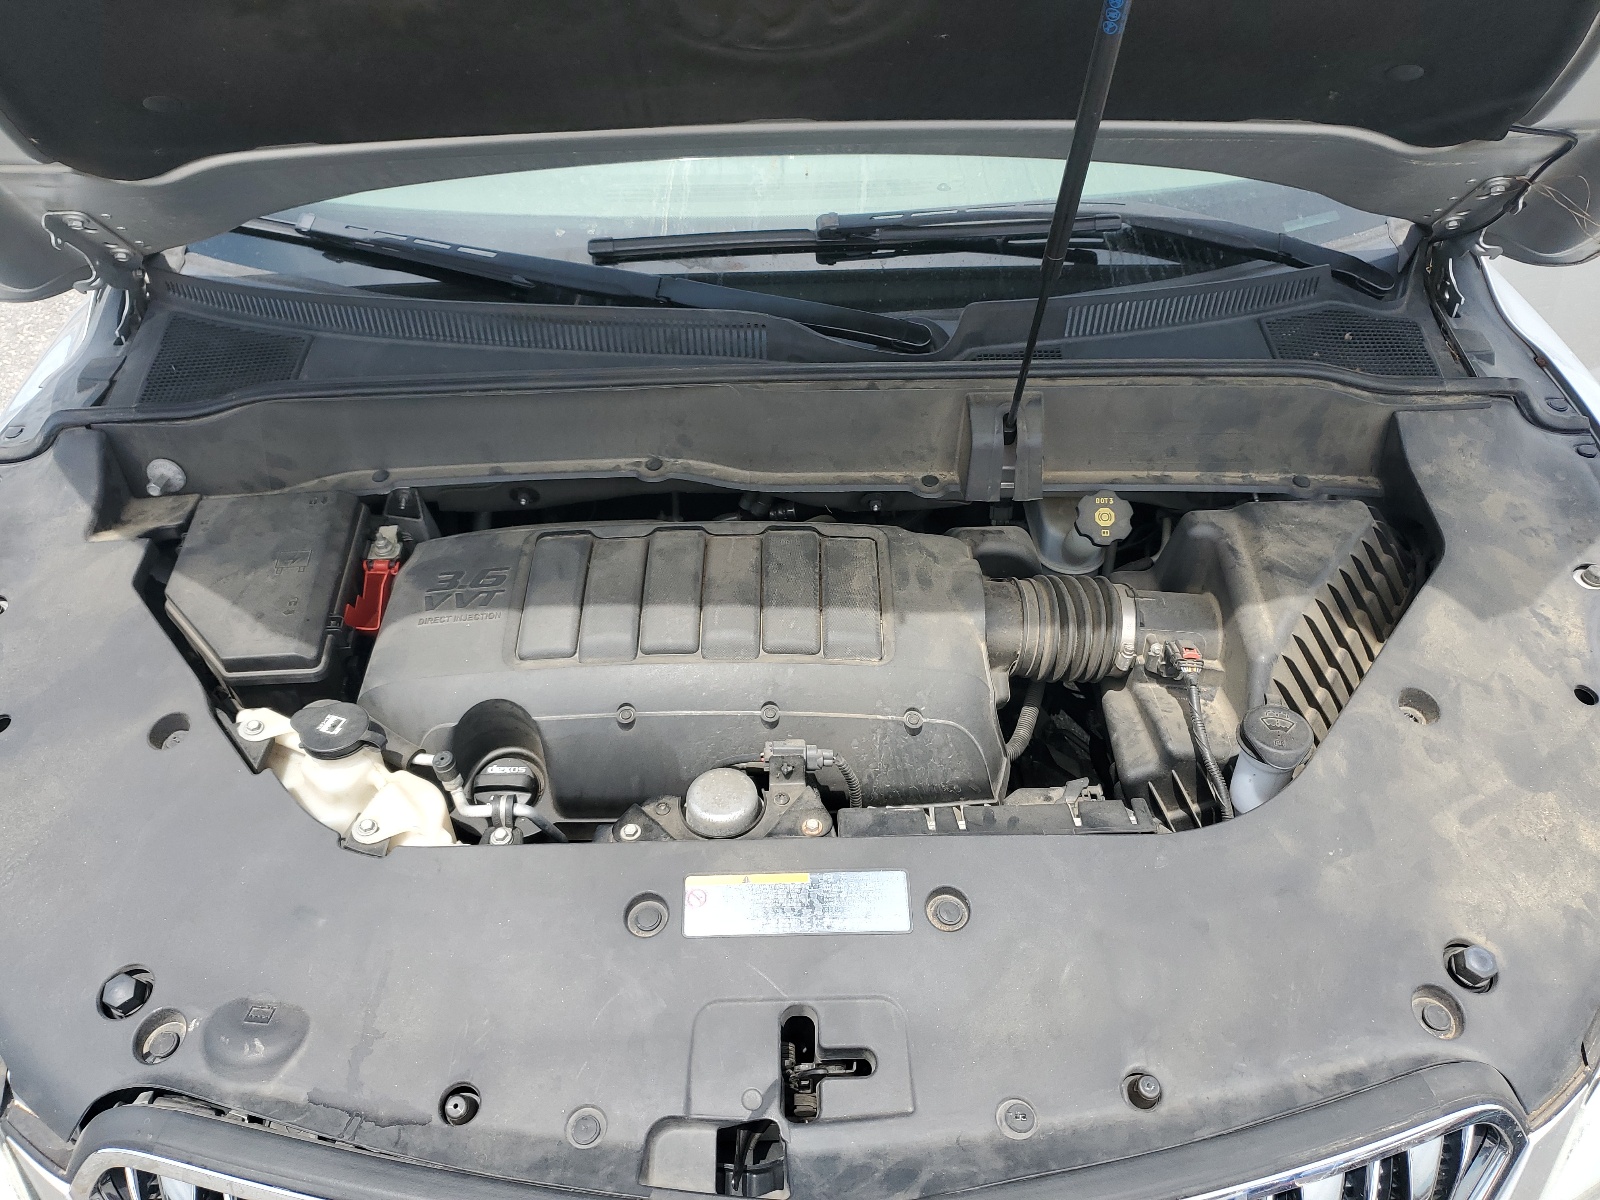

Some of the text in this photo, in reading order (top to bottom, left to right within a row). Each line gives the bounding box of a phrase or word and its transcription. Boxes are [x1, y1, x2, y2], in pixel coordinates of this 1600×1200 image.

[425, 567, 511, 592] 3.6
[424, 589, 505, 611] VVT
[417, 611, 502, 626] DIRECT INJECTION
[487, 764, 527, 774] dexos
